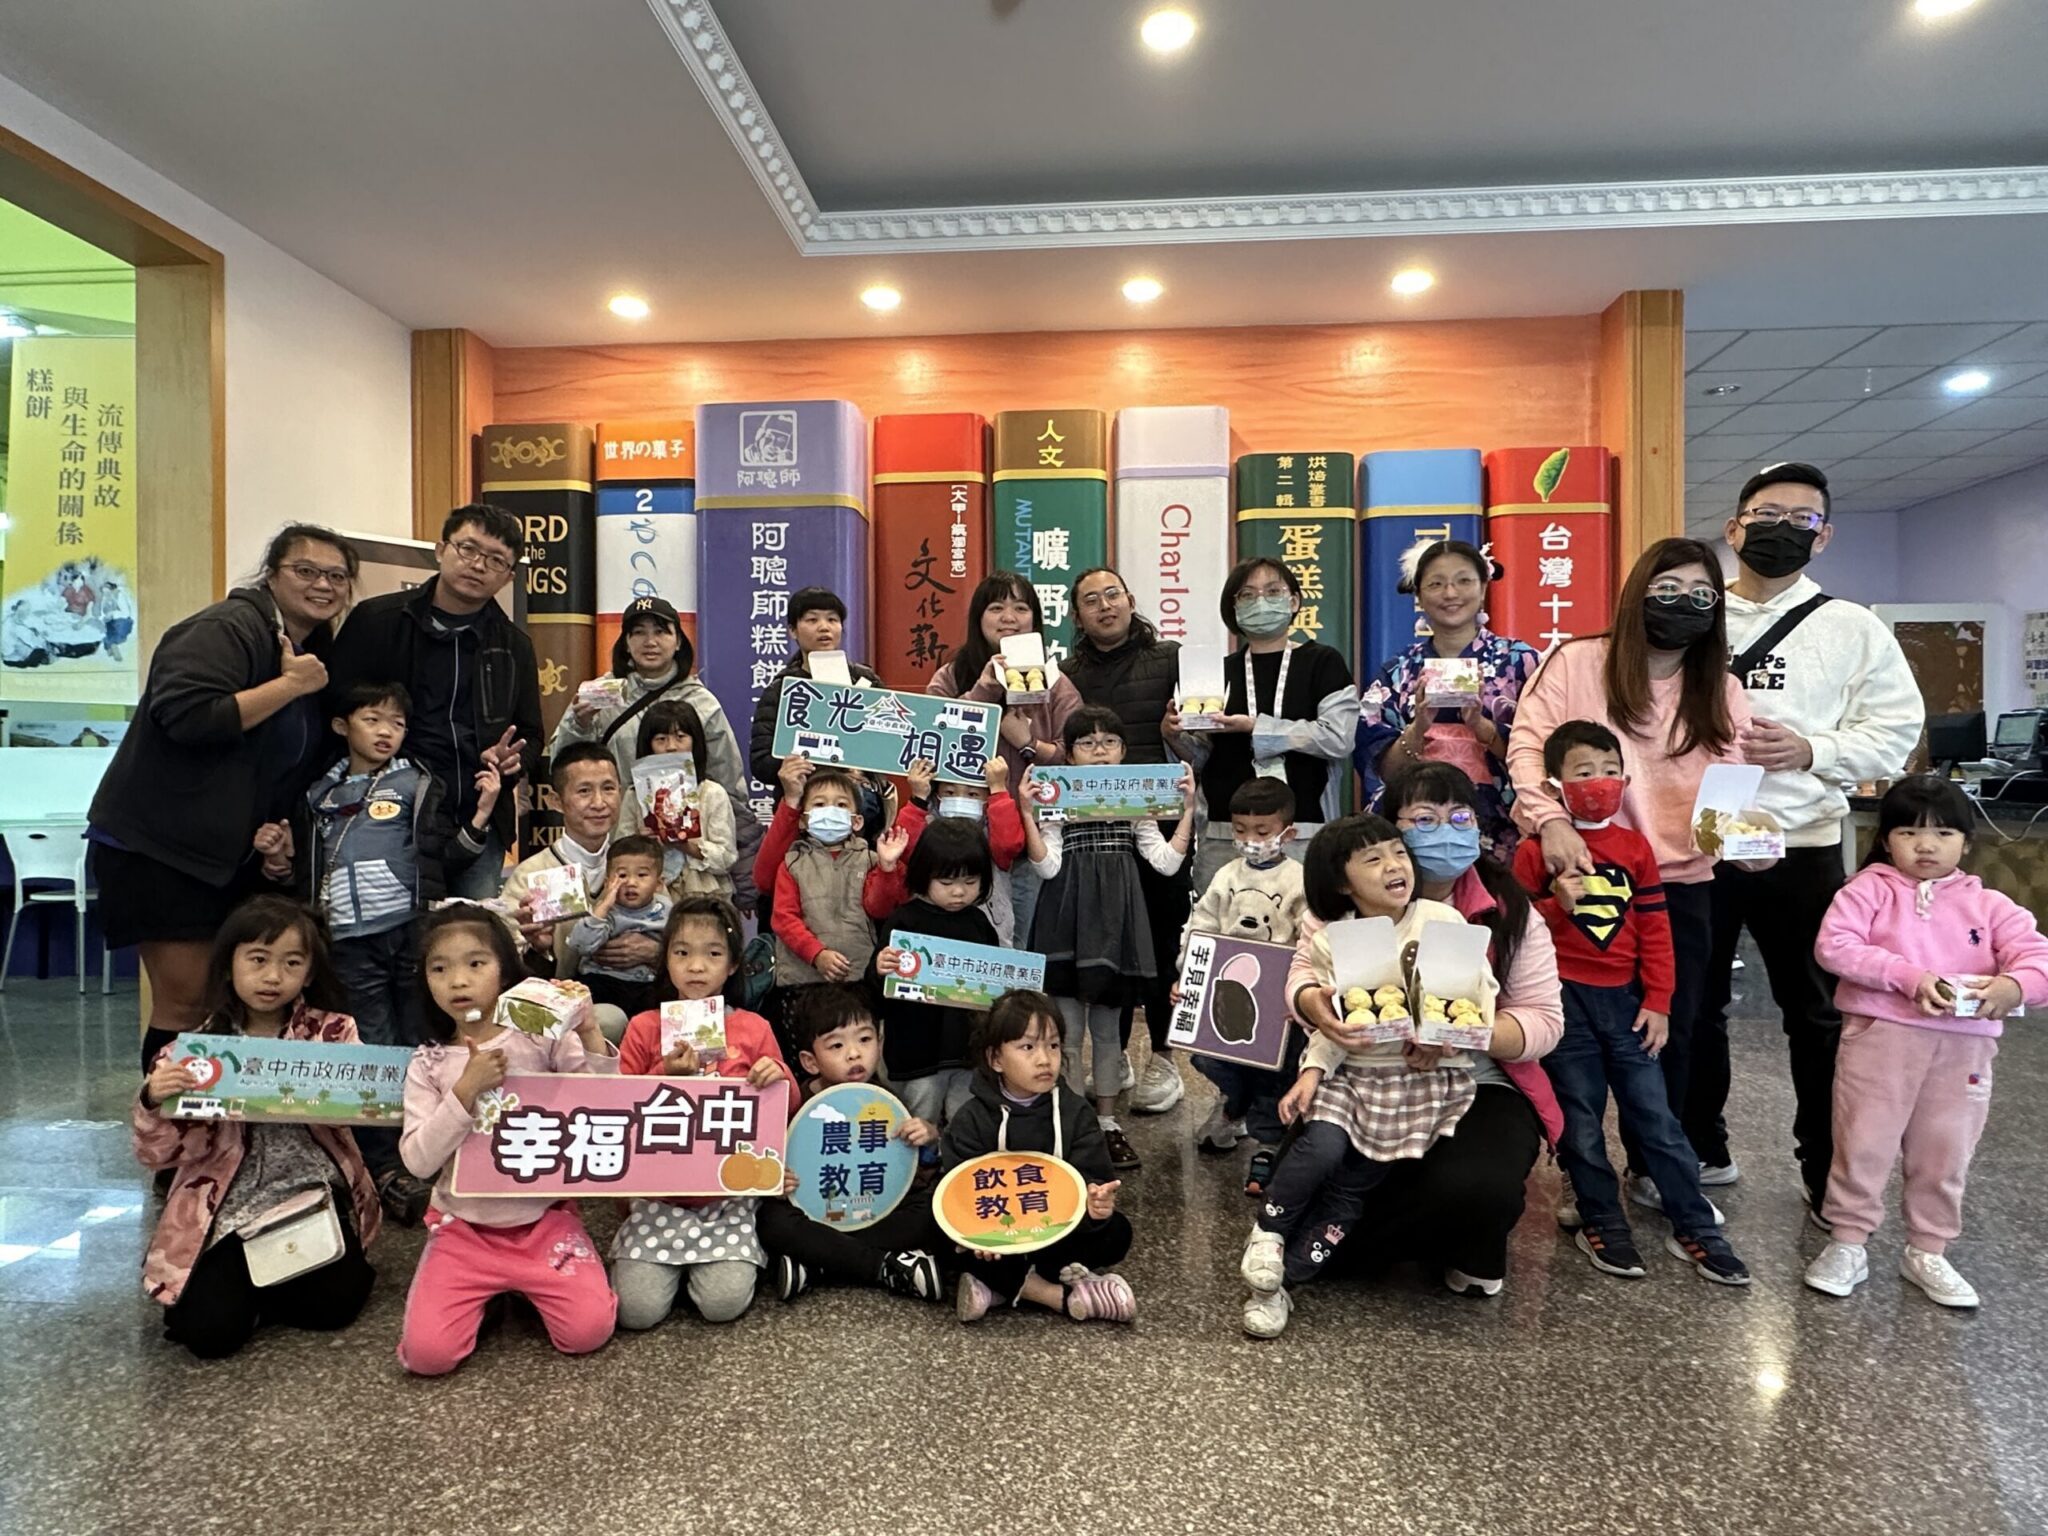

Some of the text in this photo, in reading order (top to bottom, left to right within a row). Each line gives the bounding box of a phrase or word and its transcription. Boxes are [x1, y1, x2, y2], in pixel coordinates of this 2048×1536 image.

[25, 368, 54, 420] 糕餅
[94, 402, 124, 509] 流傳典故
[603, 438, 686, 461] 世界の菓子
[1037, 419, 1066, 467] 人文
[56, 386, 89, 547] 與生命的關係
[635, 489, 653, 512] 2
[513, 515, 568, 542] RD
[783, 680, 865, 733] 食光
[900, 727, 987, 782] 相遇
[934, 953, 1042, 984] 臺中市政府農業局
[1175, 945, 1210, 1033] 芋見幸福
[242, 1057, 409, 1083] 臺中市政府農業
[494, 1086, 757, 1181] 幸福台中
[820, 1119, 889, 1155] 農事
[818, 1161, 888, 1199] 教育
[973, 1163, 1047, 1192] 飲食
[976, 1190, 1050, 1219] 教育
